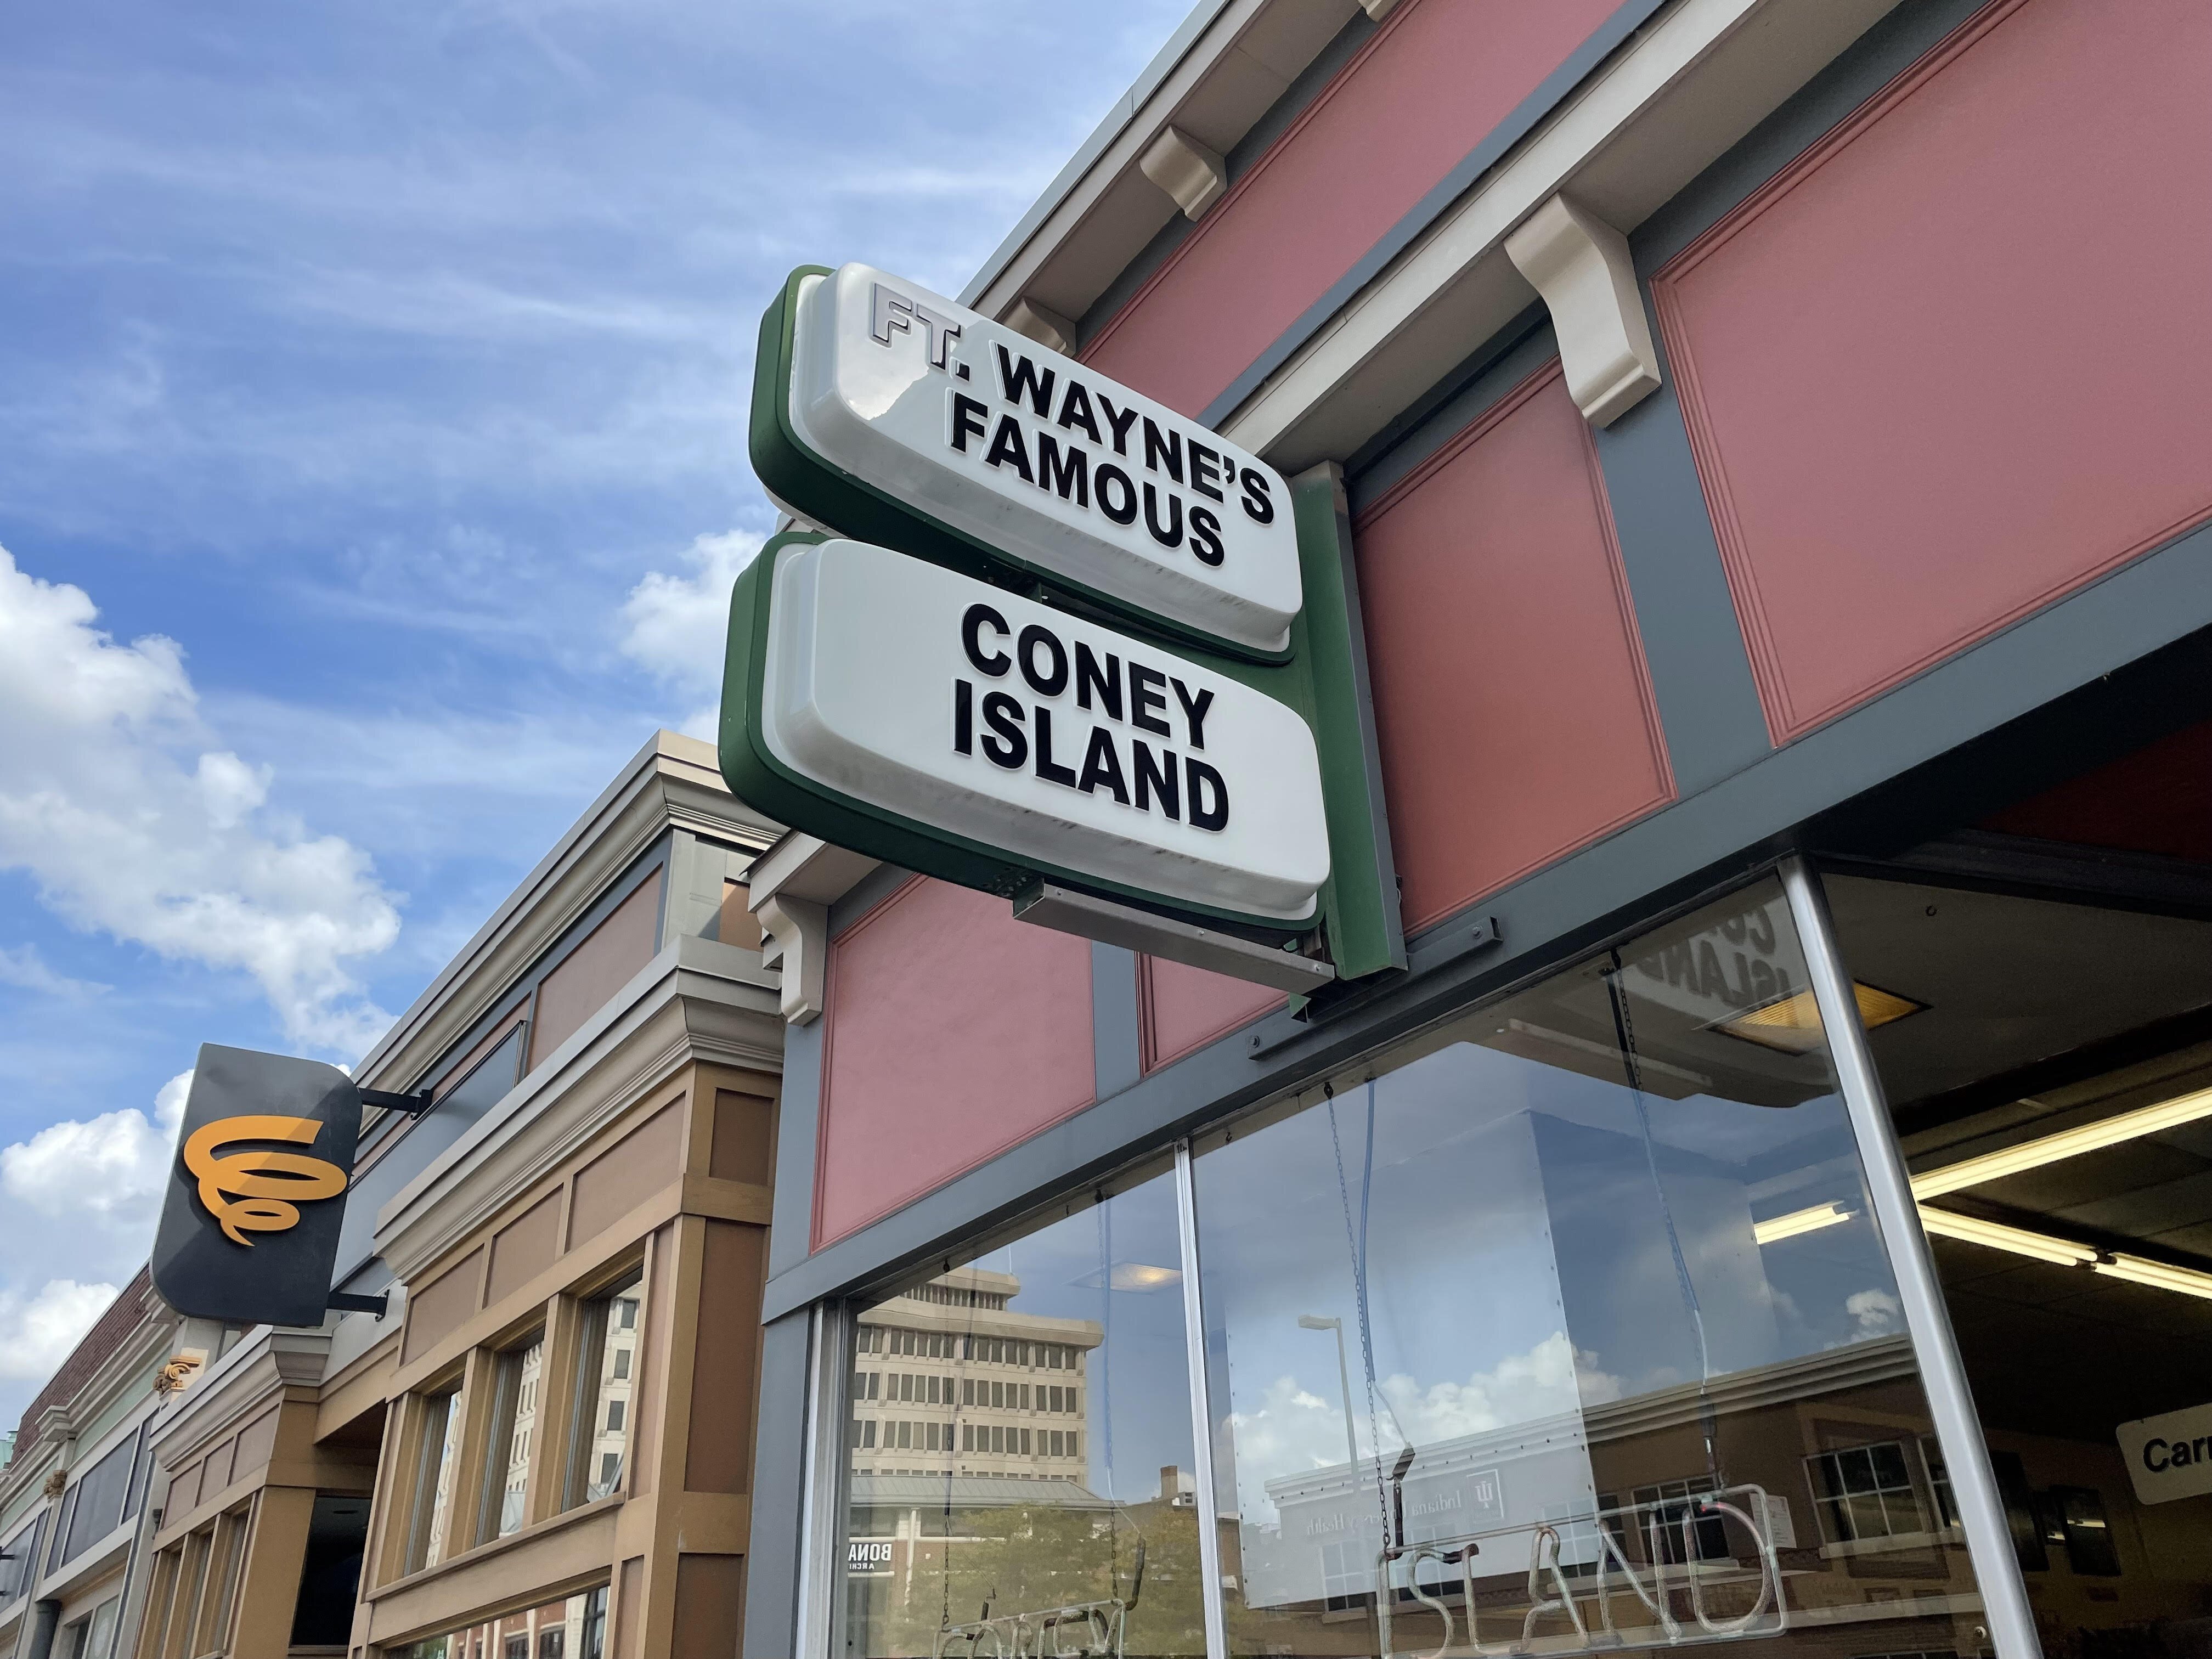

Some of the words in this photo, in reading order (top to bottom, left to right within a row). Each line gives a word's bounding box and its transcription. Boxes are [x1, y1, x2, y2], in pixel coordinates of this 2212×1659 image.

[872, 282, 970, 382] FT.
[996, 342, 1274, 524] WAYNE'S
[950, 392, 1224, 567] FAMOUS
[954, 679, 1229, 832] ISLAND
[962, 603, 1215, 750] CONEY
